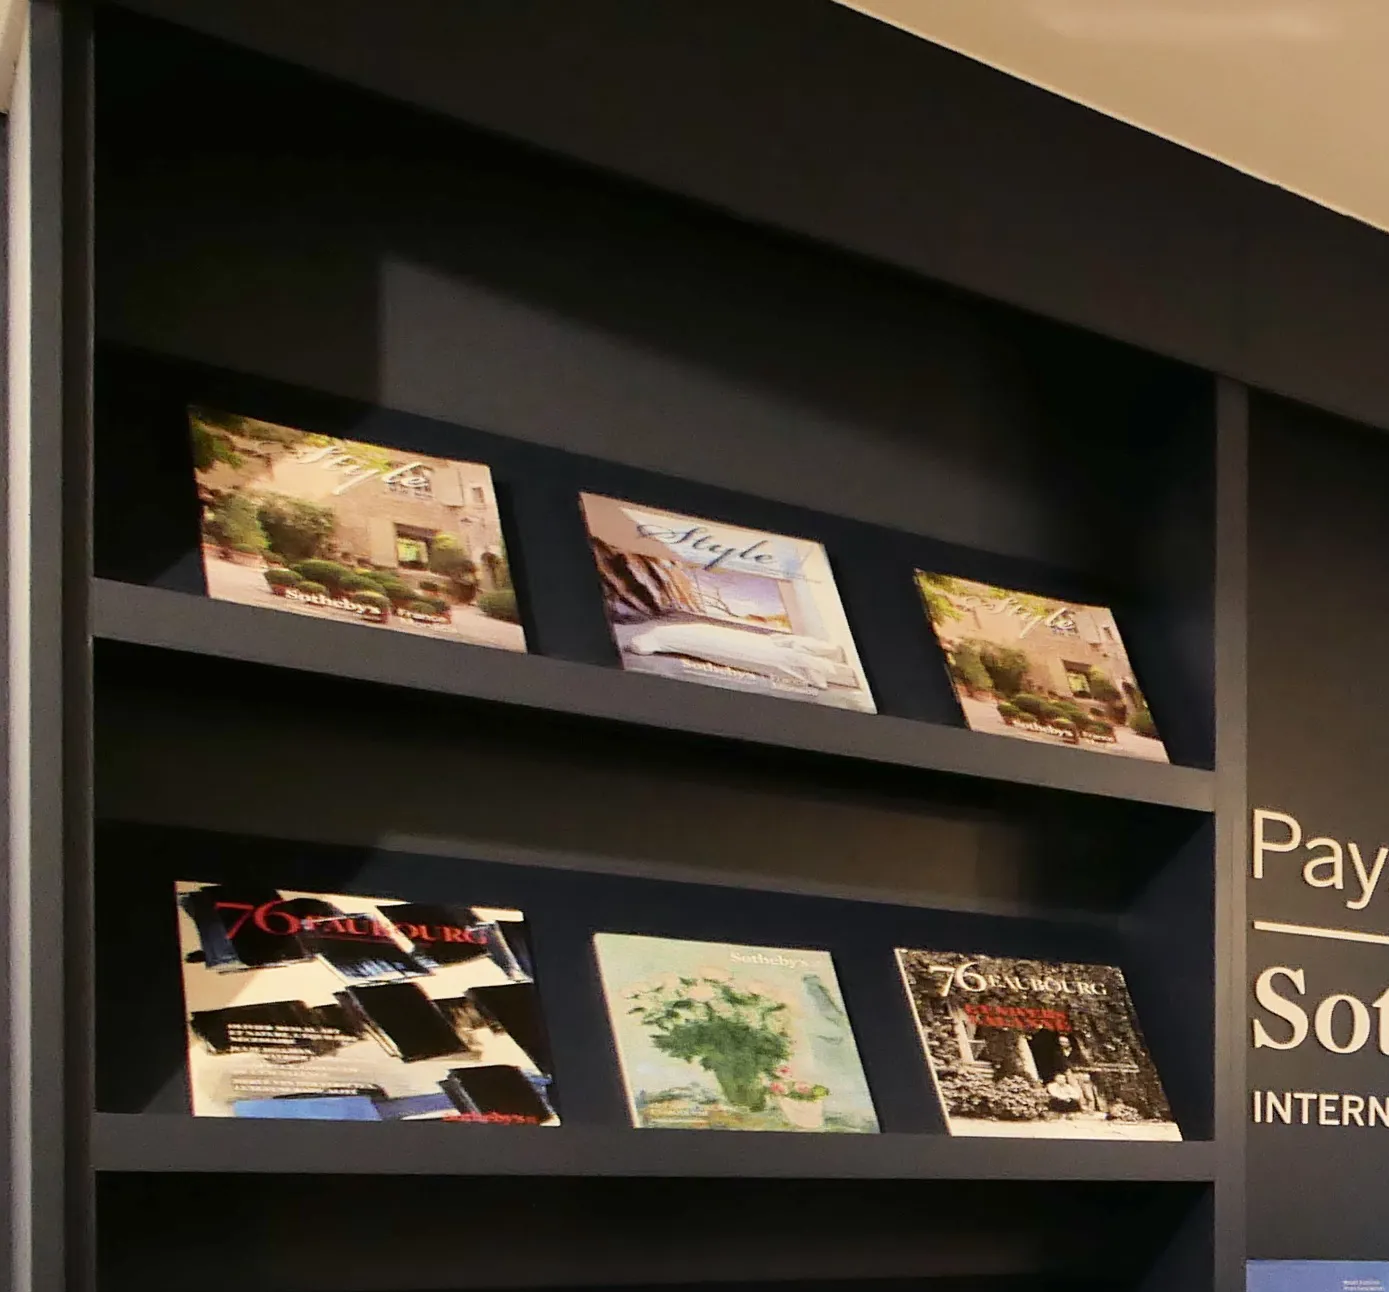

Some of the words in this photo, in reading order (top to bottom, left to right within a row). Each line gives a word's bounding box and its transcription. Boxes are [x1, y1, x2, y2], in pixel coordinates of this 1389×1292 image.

[636, 523, 776, 571] Style
[285, 588, 382, 616] Sotheby's
[929, 962, 987, 997] 76
